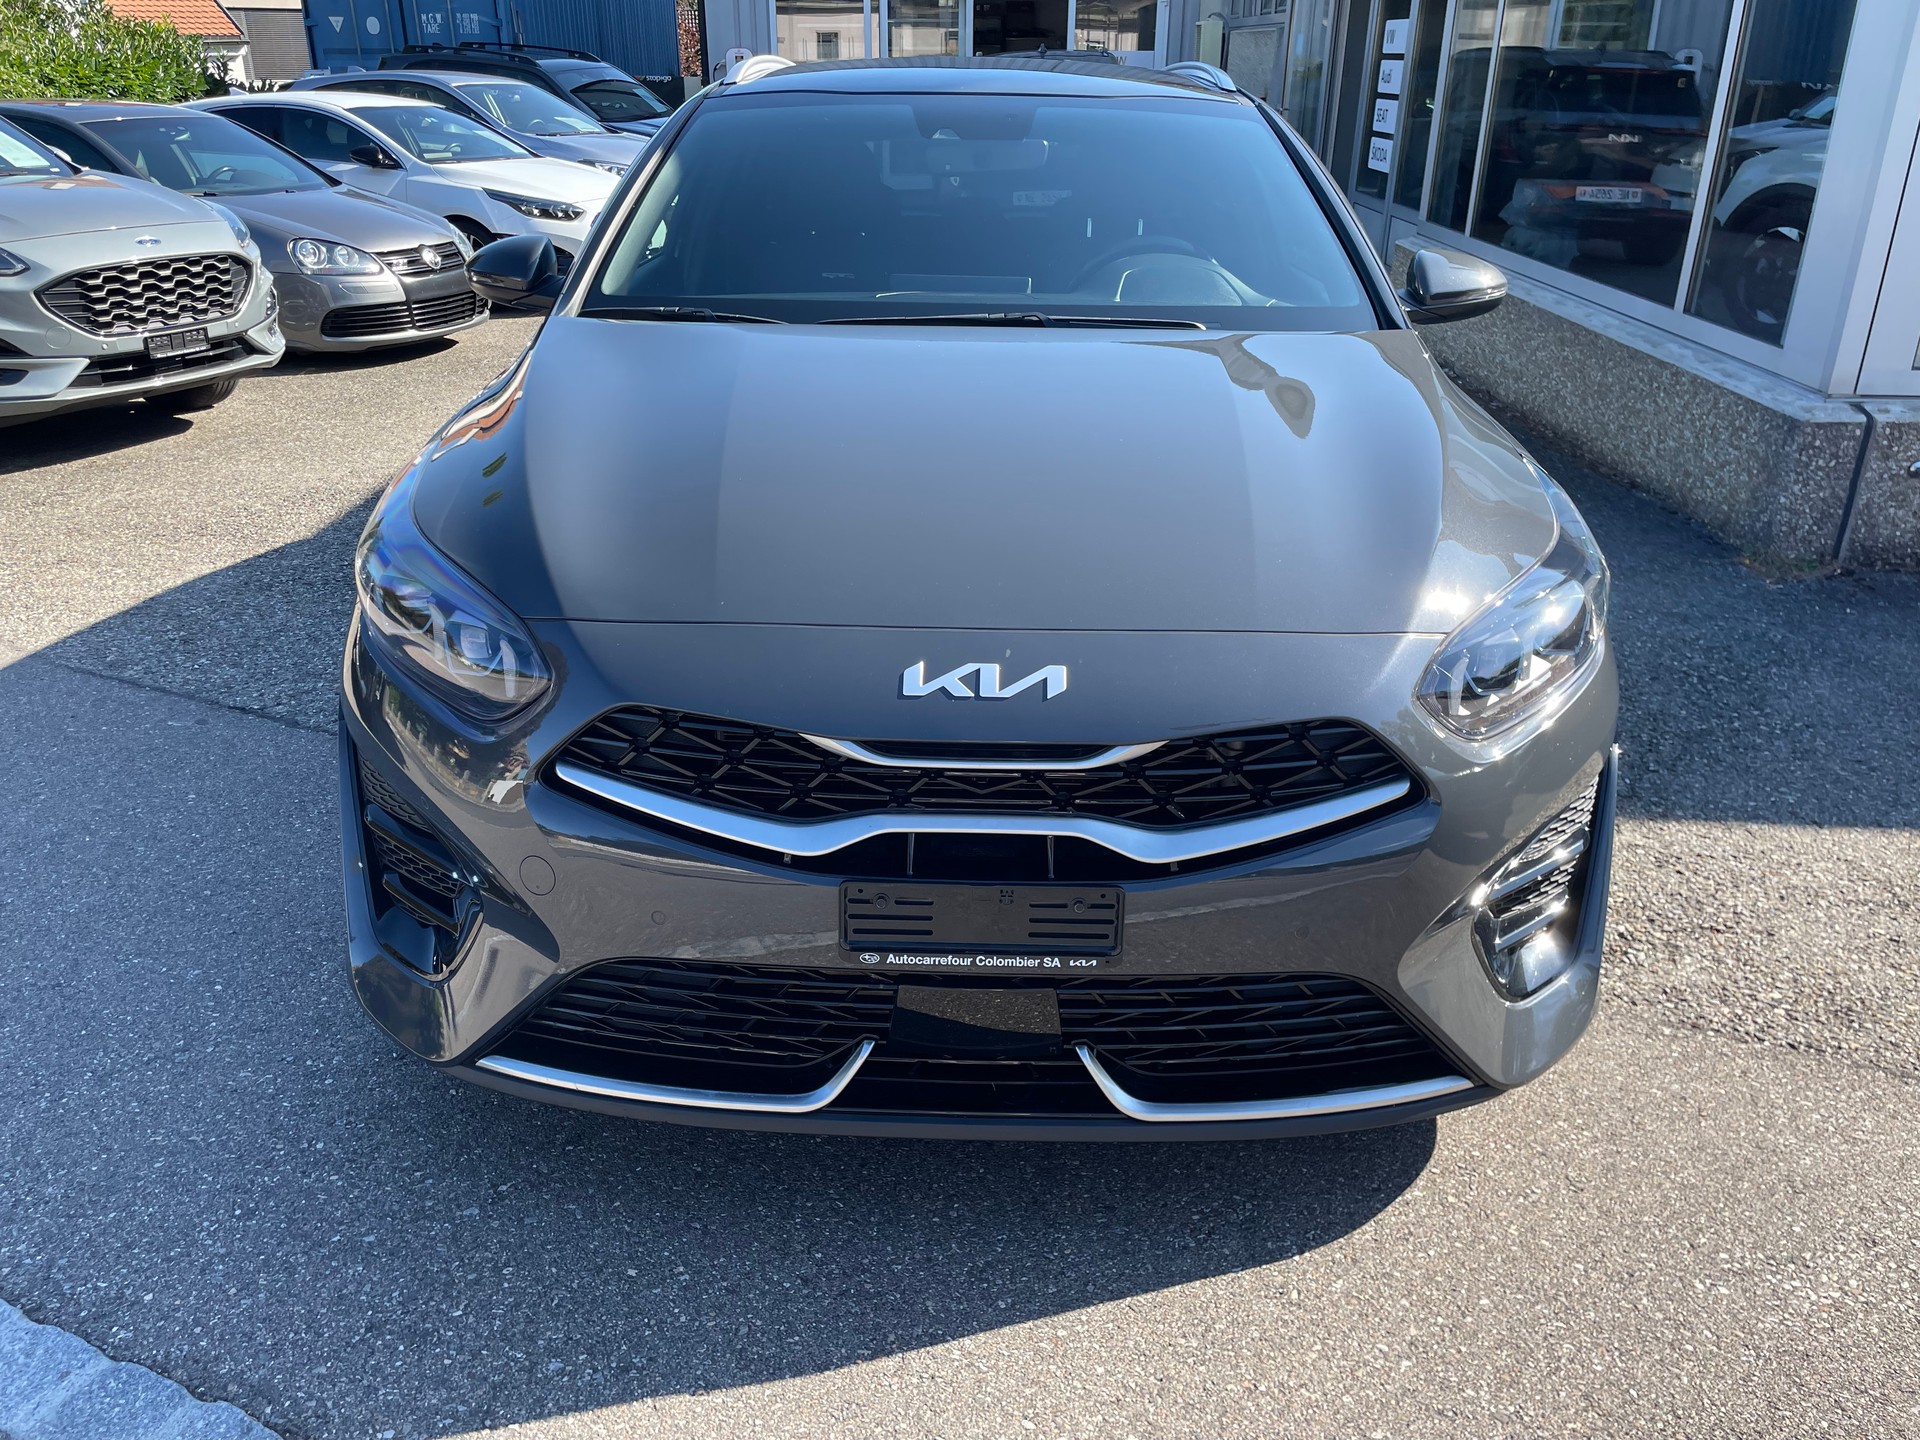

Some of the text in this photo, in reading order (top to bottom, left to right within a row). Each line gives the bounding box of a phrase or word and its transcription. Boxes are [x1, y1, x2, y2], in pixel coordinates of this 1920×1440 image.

[422, 23, 441, 34] TARE
[1381, 69, 1392, 83] Audi
[1376, 108, 1388, 123] SEAT
[903, 660, 1068, 700] KIA
[886, 953, 1097, 968] Autocarrefour Colombier SA KIA
